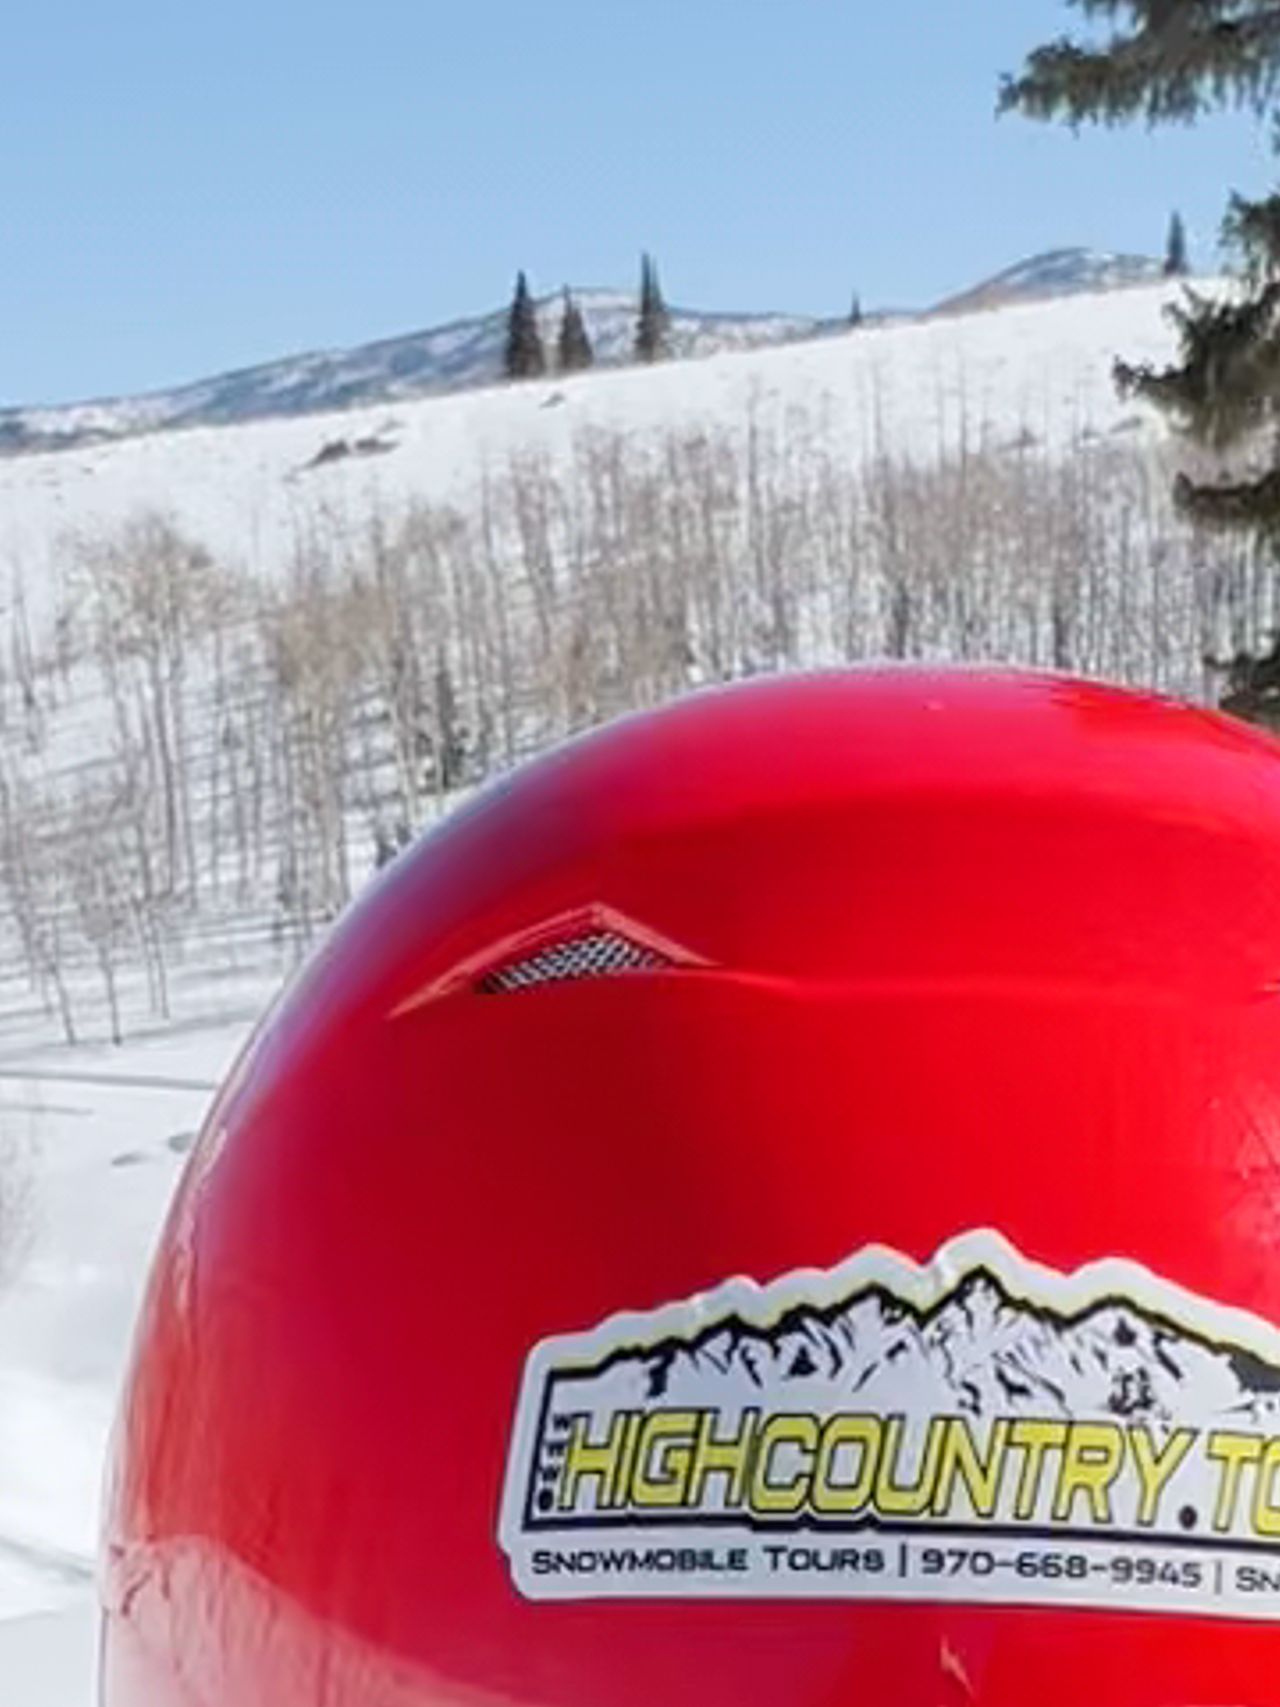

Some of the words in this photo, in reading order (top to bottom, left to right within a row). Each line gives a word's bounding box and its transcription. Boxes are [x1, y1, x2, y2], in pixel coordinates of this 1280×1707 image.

[531, 1548, 749, 1575] SNOWMOBILE
[763, 1546, 885, 1572] TOURS
[921, 1548, 1202, 1588] 970-668-9945
